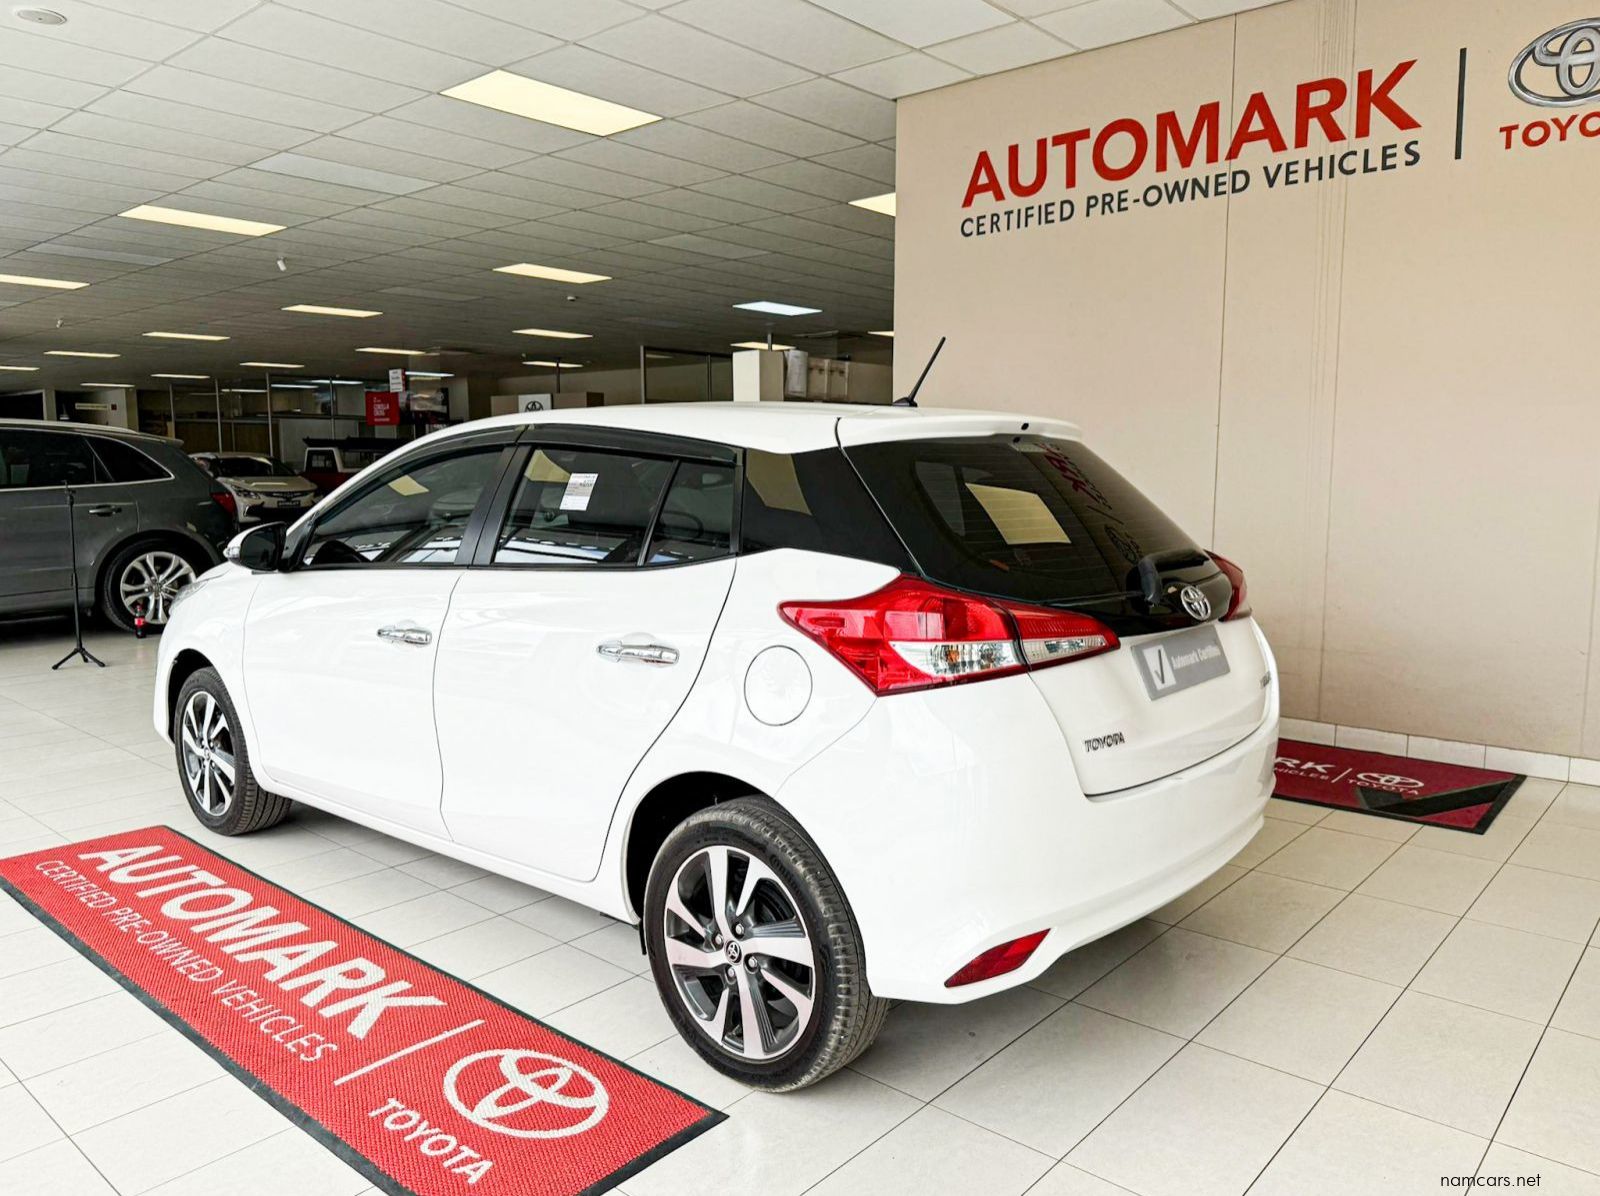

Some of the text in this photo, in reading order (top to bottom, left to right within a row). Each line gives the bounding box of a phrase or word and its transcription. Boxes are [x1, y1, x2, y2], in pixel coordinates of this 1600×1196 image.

[963, 61, 1421, 208] AUTOMARK
[961, 141, 1421, 238] CERTIFIED PRE-OWNED VEHICLES
[1085, 731, 1125, 752] TOYOTA
[1348, 779, 1419, 795] TOYOTA
[36, 859, 338, 1062] CERTIFIED PRE-OWNED VEHICLES
[78, 845, 447, 1041] AUTOMARK
[369, 1097, 492, 1185] TOYOTA
